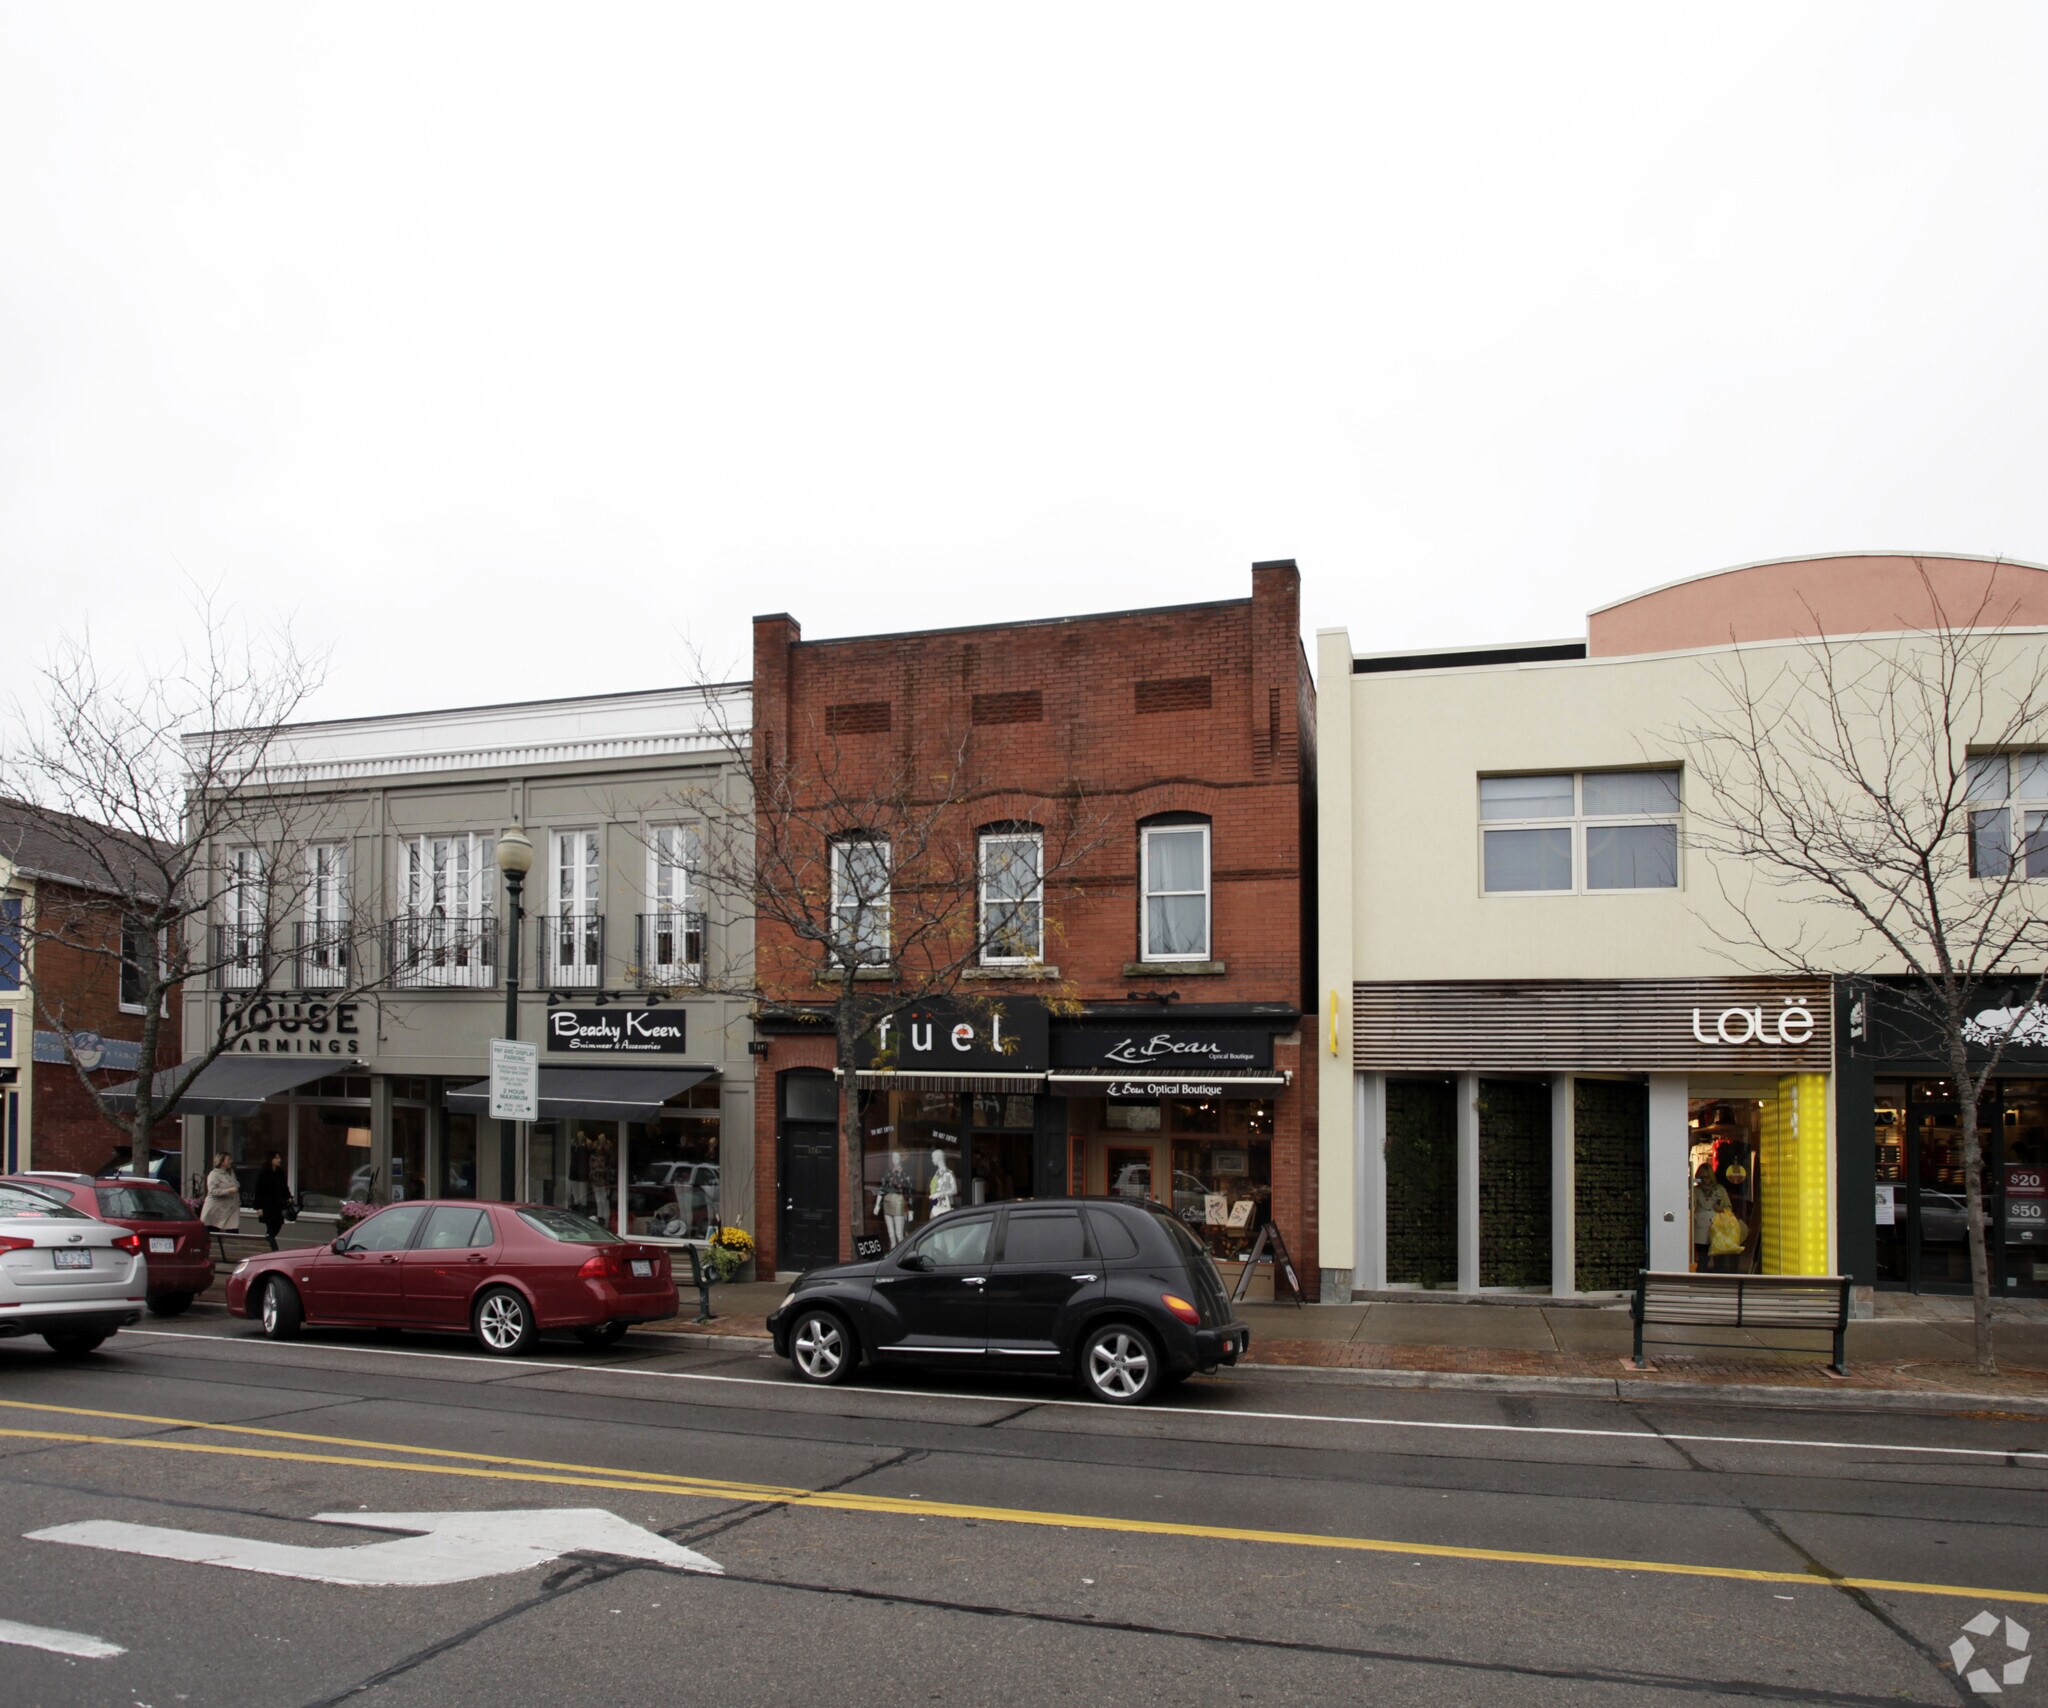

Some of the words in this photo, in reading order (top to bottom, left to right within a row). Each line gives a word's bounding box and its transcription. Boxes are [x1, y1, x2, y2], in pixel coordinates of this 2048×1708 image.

[220, 1002, 358, 1033] HOUSE
[550, 1011, 620, 1042] Beachy
[626, 1012, 682, 1037] Keen
[223, 1038, 358, 1053] ARMINGS
[569, 1038, 613, 1049] Swimwear
[620, 1039, 661, 1050] Accessories
[1104, 1038, 1156, 1064] Le
[1229, 1053, 1255, 1061] Boutique
[1106, 1082, 1121, 1096] Le
[1147, 1083, 1180, 1097] Optical
[1181, 1084, 1222, 1096] Boutique
[876, 1127, 884, 1135] NOT
[932, 1130, 939, 1138] DO
[945, 1134, 957, 1143] ENTER
[2010, 1174, 2041, 1187] $20
[2011, 1204, 2042, 1217] $50
[857, 1239, 882, 1256] BCBG
